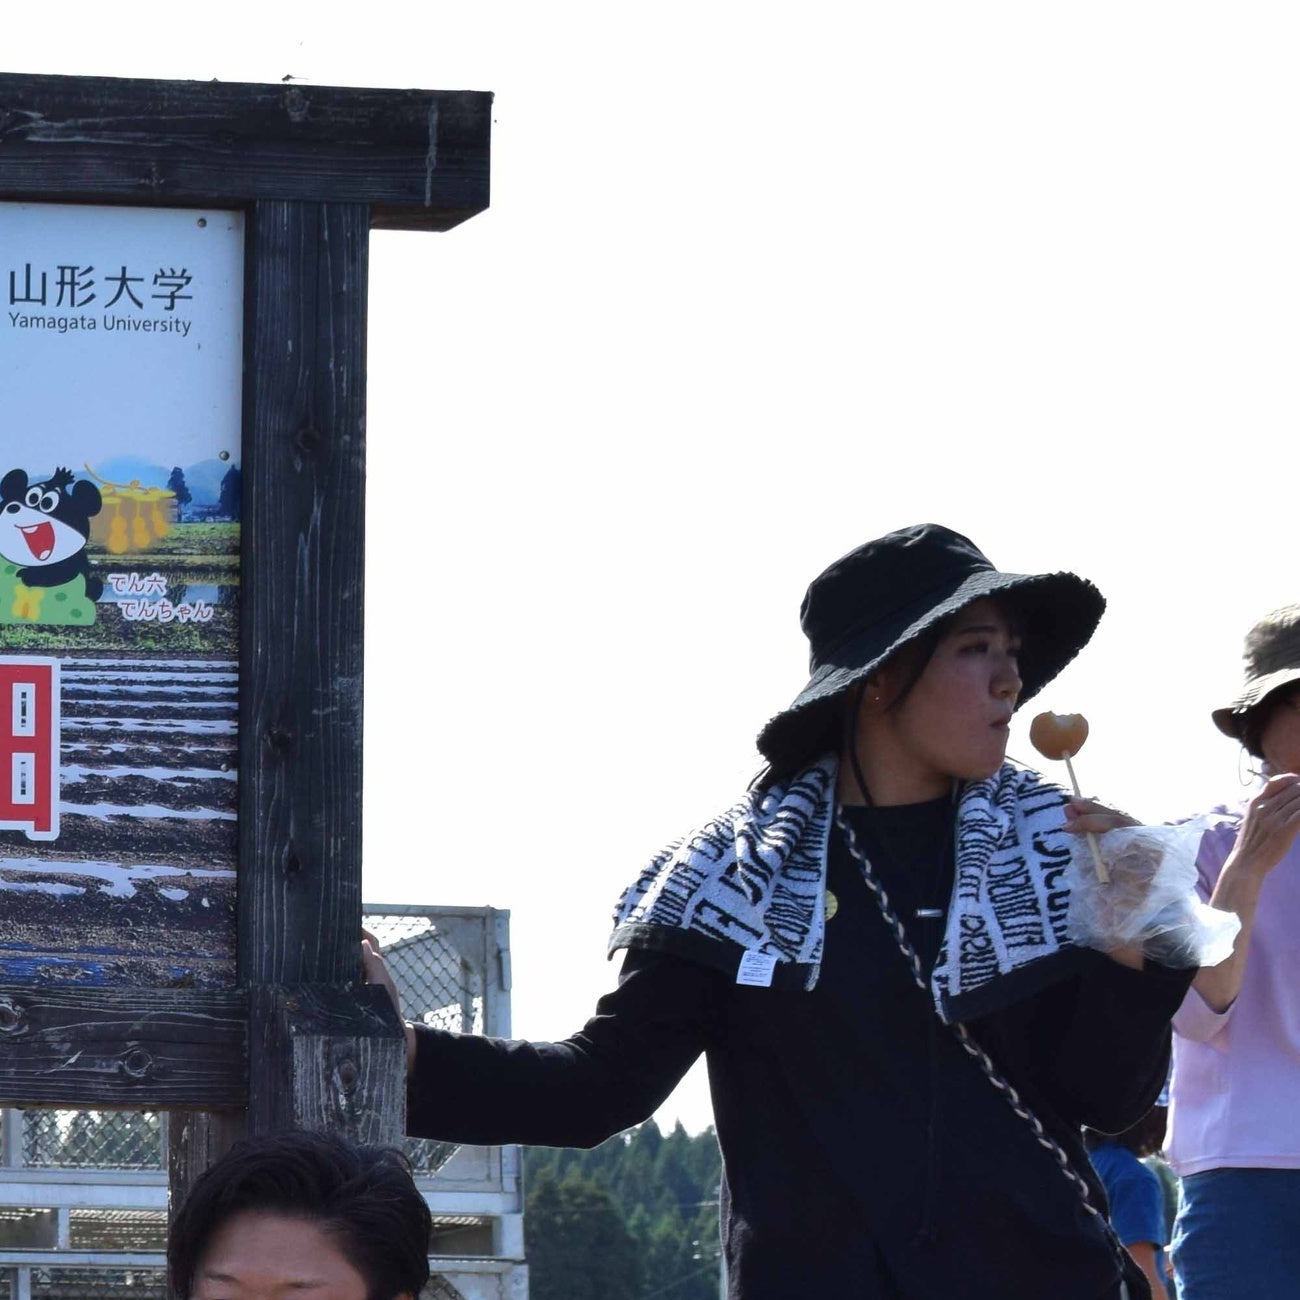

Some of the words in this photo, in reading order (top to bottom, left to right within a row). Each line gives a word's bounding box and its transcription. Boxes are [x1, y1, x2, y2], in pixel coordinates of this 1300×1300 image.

[9, 262, 193, 312] 山形大学
[8, 312, 97, 334] Yamagata
[103, 314, 192, 337] University
[110, 574, 165, 593] でん六
[120, 600, 212, 620] でんちゃん
